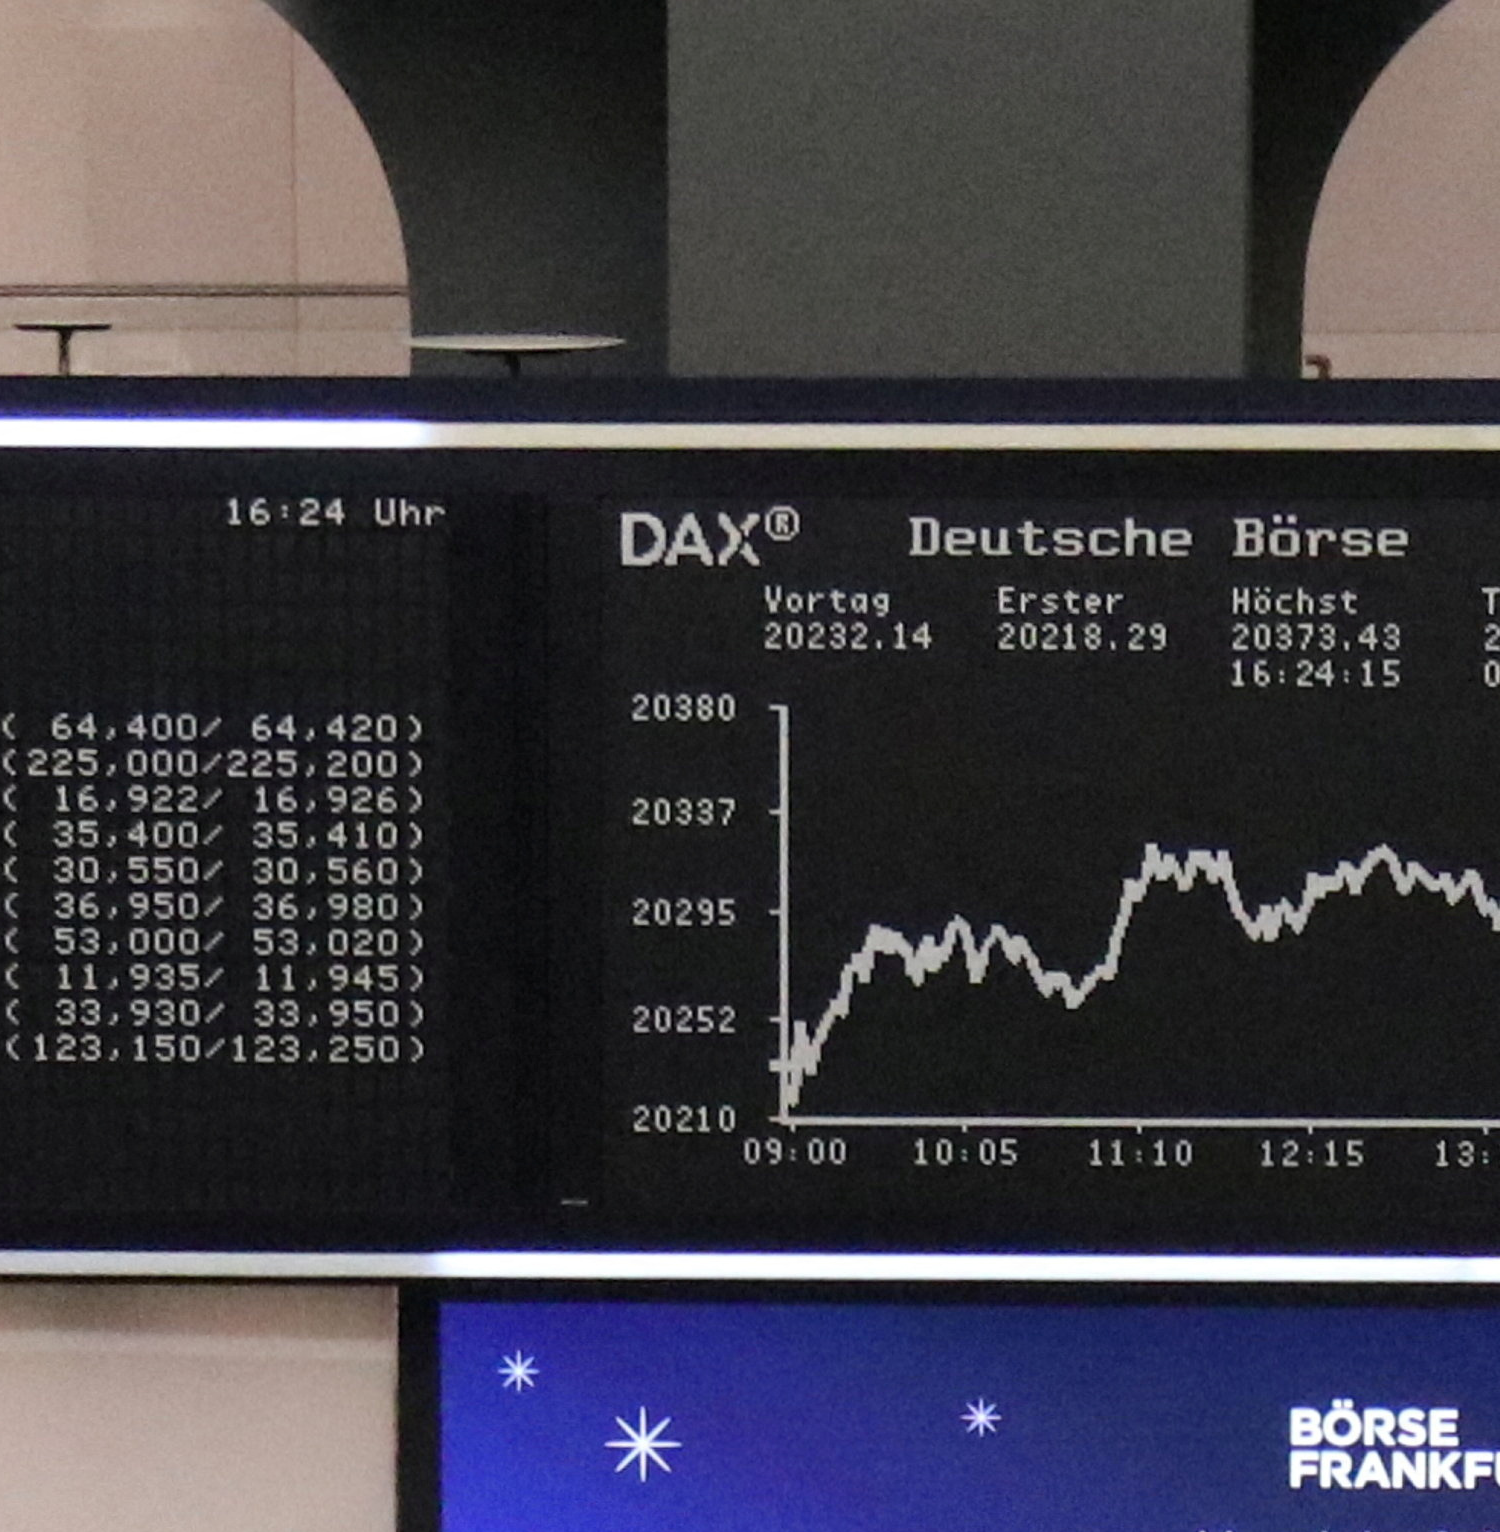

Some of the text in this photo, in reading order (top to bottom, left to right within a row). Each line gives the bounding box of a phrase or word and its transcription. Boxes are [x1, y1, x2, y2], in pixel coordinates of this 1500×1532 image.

[228, 497, 446, 527] 16:24 Uhr
[909, 516, 1193, 557] Deutsche
[1232, 513, 1409, 557] Börse
[764, 585, 890, 618] Vortag
[998, 585, 1124, 615] Erster
[1232, 586, 1358, 615] Höchst
[764, 621, 933, 651] 20232.14
[998, 621, 1167, 651] 20218.29
[1232, 622, 1401, 651] 20373.43
[1231, 658, 1401, 688] 16:24:15
[631, 693, 736, 722] 20380
[631, 797, 736, 826] 20337
[632, 897, 736, 927] 20295
[632, 1004, 736, 1034] 20252
[633, 1104, 736, 1133] 20210
[743, 1137, 847, 1165] 09:00
[914, 1137, 1018, 1166] 10:05
[1090, 1138, 1192, 1167] 11:10
[1261, 1139, 1364, 1167] 12:15
[1289, 1398, 1460, 1448] BÖRSE
